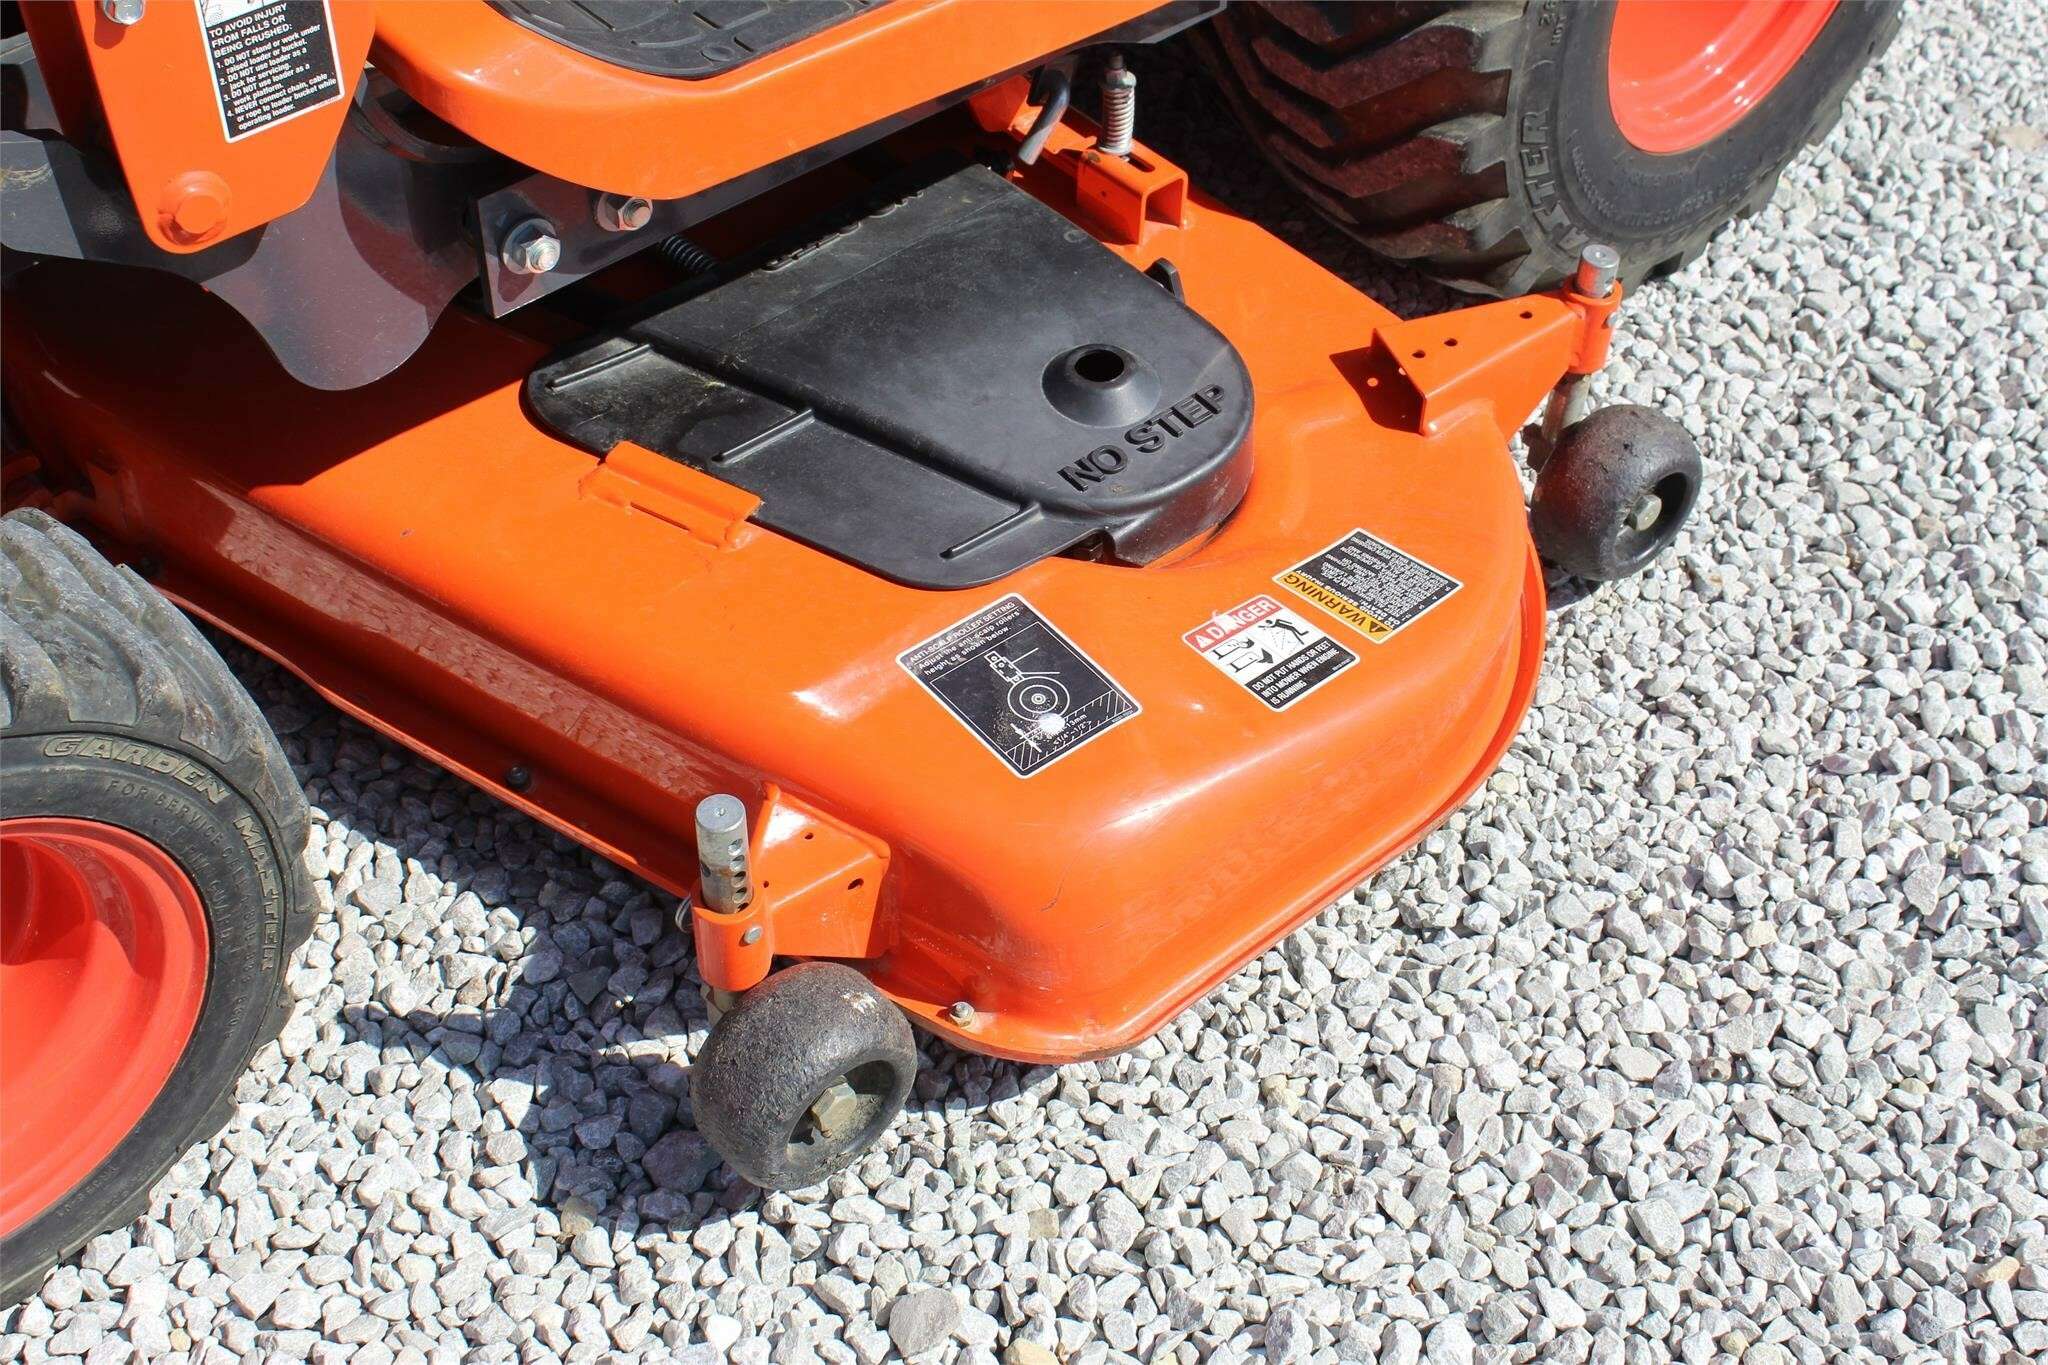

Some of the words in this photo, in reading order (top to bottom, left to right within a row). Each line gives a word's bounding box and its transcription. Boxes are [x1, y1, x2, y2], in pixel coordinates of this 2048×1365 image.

[208, 27, 222, 38] TO
[223, 15, 252, 32] AVOID
[253, 2, 287, 21] INJURY
[211, 31, 239, 48] FROM
[240, 20, 270, 37] FALLS
[271, 14, 285, 26] OR
[213, 40, 243, 58] BEING
[244, 21, 292, 46] CRUSHED:
[223, 56, 235, 66] DO
[235, 50, 250, 61] NOT
[251, 42, 271, 55] stand
[272, 39, 280, 47] or
[281, 32, 298, 44] work
[300, 23, 320, 37] under
[226, 59, 249, 74] raised
[249, 51, 272, 65] loader
[272, 48, 280, 56] or
[280, 37, 307, 53] bucket.
[227, 72, 238, 82] DO
[239, 66, 254, 77] NOT
[255, 62, 268, 71] use
[268, 52, 291, 66] loader
[292, 49, 301, 57] as
[229, 78, 245, 91] jack
[246, 74, 256, 83] for
[257, 60, 291, 81] servicing.
[231, 88, 242, 98] DO
[242, 82, 257, 94] NOT
[258, 78, 271, 87] use
[271, 68, 294, 82] loader
[295, 65, 304, 73] as
[232, 94, 251, 106] work
[252, 80, 284, 100] platform.
[234, 100, 257, 114] NEVER
[258, 88, 286, 105] connect
[308, 71, 327, 85] cable
[236, 114, 245, 122] or
[245, 107, 261, 120] rope
[262, 103, 270, 111] to
[270, 94, 292, 108] loader
[293, 84, 317, 99] bucket
[317, 76, 336, 89] while
[238, 111, 271, 131] operating
[271, 101, 295, 117] loader.
[1058, 444, 1128, 492] NO
[1125, 384, 1225, 453] STEP
[1296, 569, 1324, 586] INJURY
[1324, 585, 1359, 606] SERIOUS
[1283, 573, 1370, 626] WARNING
[1359, 606, 1384, 621] AVOID
[952, 618, 984, 639] ROLLER
[981, 600, 1016, 622] SETTING
[1384, 620, 1396, 628] TO
[1388, 617, 1401, 625] OR
[916, 652, 945, 670] Adjust
[941, 645, 957, 655] the
[956, 623, 996, 648] anti-scalp
[923, 658, 951, 676] height
[949, 653, 961, 661] as
[959, 638, 986, 655] shown
[984, 624, 1011, 641] below.
[1250, 681, 1265, 691] DO
[1260, 673, 1278, 685] NOT
[1273, 665, 1290, 677] PUT
[1285, 653, 1310, 669] HANDS
[1305, 648, 1319, 657] OR
[1313, 640, 1332, 652] FEET
[1260, 684, 1279, 697] INTO
[1274, 670, 1302, 689] MOWER
[1297, 660, 1319, 674] WHEN
[1314, 647, 1340, 664] ENGINE
[1268, 696, 1280, 704] IS
[1275, 679, 1307, 700] RUNNING
[105, 779, 149, 804] FOR
[155, 792, 224, 847] SERVICE
[43, 735, 231, 805] GARDEN
[233, 815, 281, 972] MASTER
